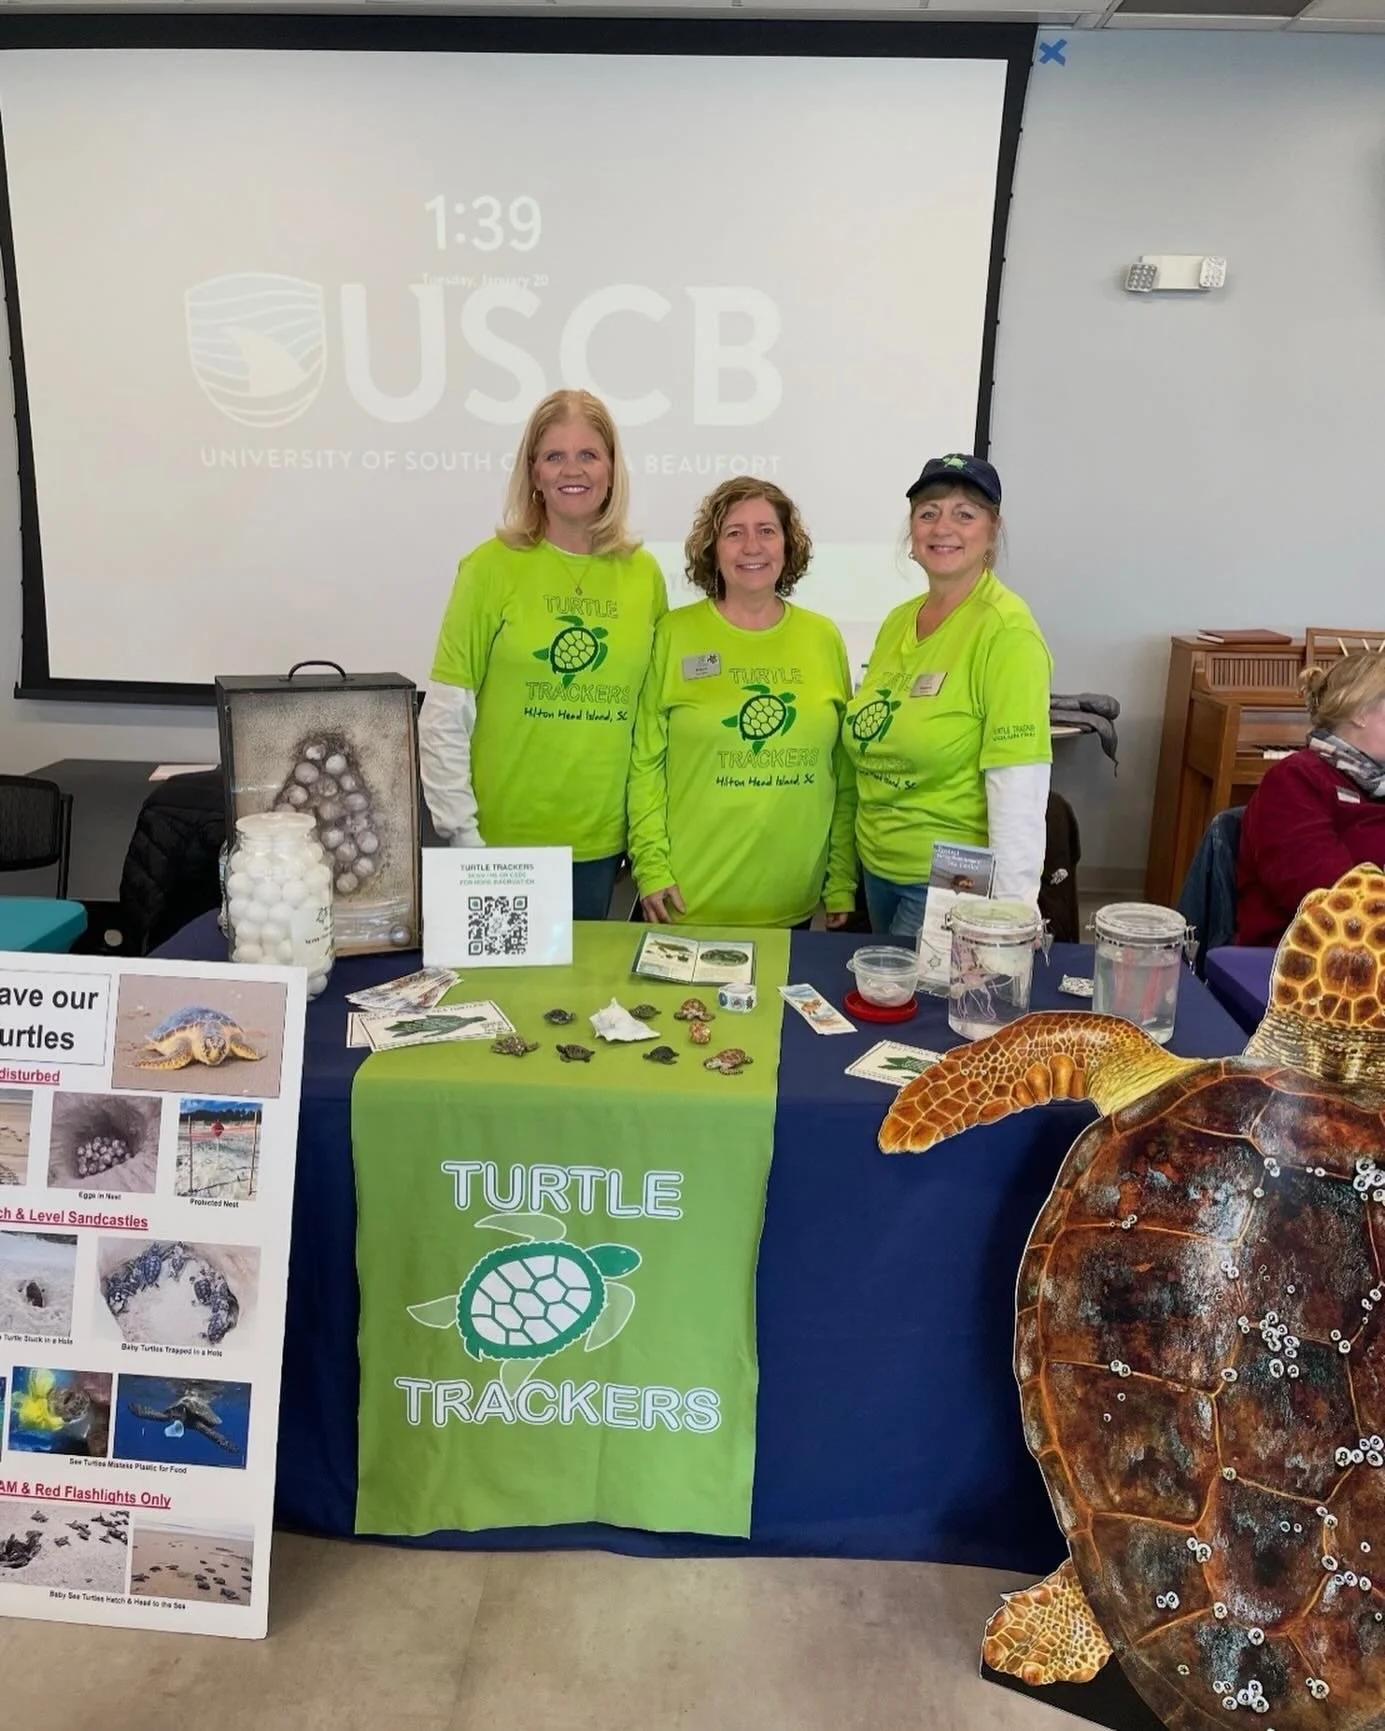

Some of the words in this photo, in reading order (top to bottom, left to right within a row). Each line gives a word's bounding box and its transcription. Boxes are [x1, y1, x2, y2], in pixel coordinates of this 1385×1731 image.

[424, 194, 542, 252] 1:39
[533, 272, 550, 287] 20
[340, 283, 784, 428] USCB
[201, 447, 351, 470] UNIVERSITY
[362, 450, 398, 470] OF
[404, 451, 491, 471] SOUTH
[645, 453, 781, 475] BEAUFORT
[543, 595, 619, 619] TURTLE
[728, 667, 804, 685] TURTLE
[526, 681, 631, 705] TRACKERS
[558, 708, 582, 721] Head
[717, 747, 820, 769] TRACKERS
[748, 775, 773, 787] Head
[460, 863, 490, 872] TURTLE
[492, 863, 535, 872] TRACKERS
[52, 989, 99, 1010] our
[78, 1191, 96, 1201] Eggs
[97, 1192, 105, 1200] in
[104, 1192, 122, 1201] Nest
[441, 1160, 684, 1220] TURTLE
[190, 1198, 222, 1208] Protected
[223, 1199, 240, 1209] Nest
[15, 1207, 25, 1220] &
[29, 1209, 65, 1223] Level
[68, 1210, 149, 1228] Sandcastles
[4, 1334, 23, 1343] Turtle
[24, 1335, 43, 1344] Stuck
[58, 1337, 73, 1346] Hole
[121, 1343, 139, 1353] Baby
[140, 1344, 163, 1354] Turtles
[165, 1345, 192, 1356] Trapped
[207, 1349, 223, 1358] Hole
[394, 1377, 721, 1433] TRACKERS
[83, 1459, 106, 1468] Turtles
[107, 1461, 133, 1470] Mistake
[134, 1463, 157, 1472] Plastic
[159, 1465, 169, 1473] for
[169, 1466, 187, 1474] Food
[21, 1481, 31, 1495] &
[35, 1483, 61, 1497] Red
[64, 1485, 137, 1504] Flashlights
[140, 1492, 172, 1508] Only
[49, 1590, 67, 1599] Baby
[68, 1591, 80, 1600] Sea
[82, 1593, 104, 1603] Turtles
[105, 1596, 126, 1604] Hatch
[133, 1598, 151, 1607] Head
[161, 1600, 172, 1609] the
[173, 1602, 186, 1610] Sea
